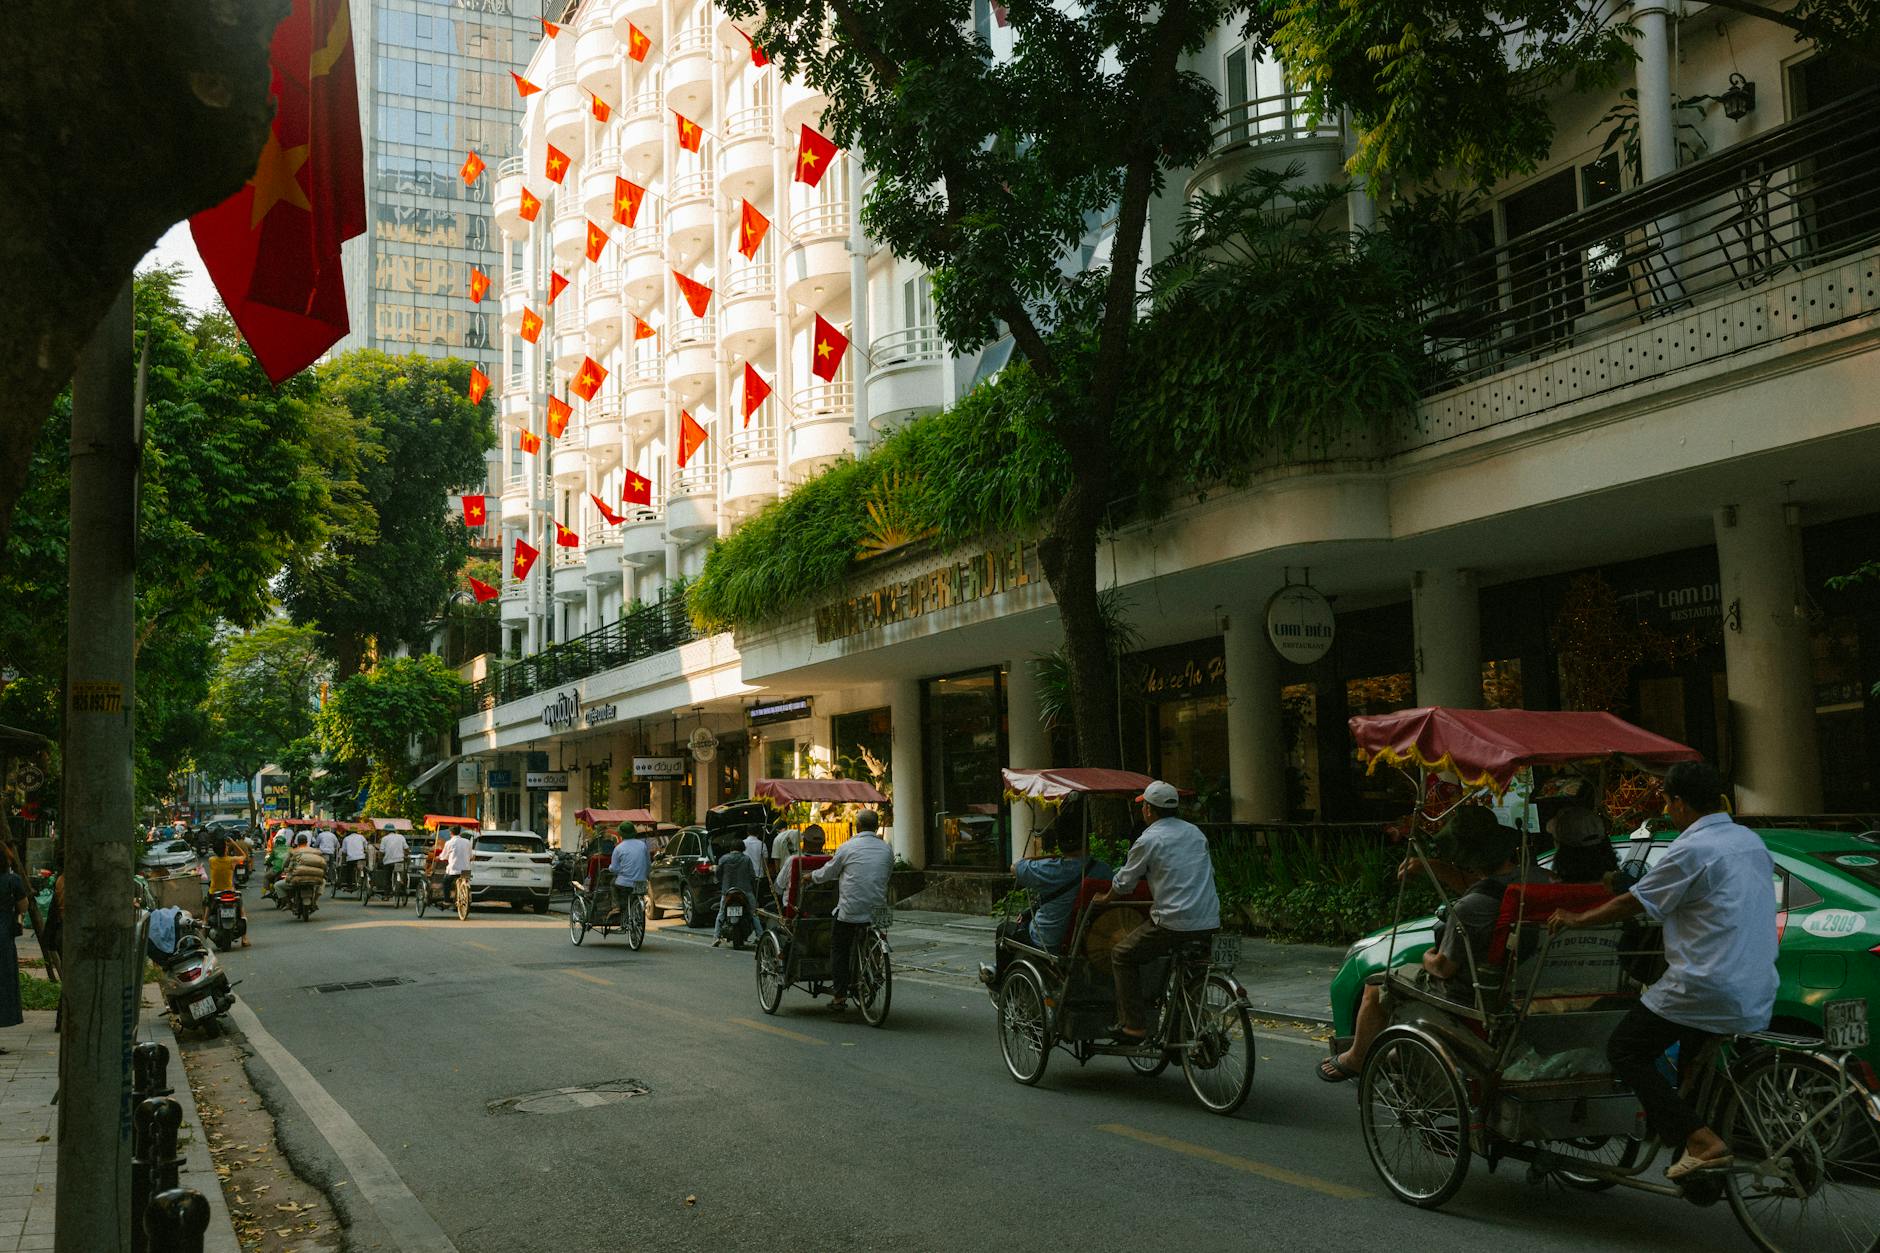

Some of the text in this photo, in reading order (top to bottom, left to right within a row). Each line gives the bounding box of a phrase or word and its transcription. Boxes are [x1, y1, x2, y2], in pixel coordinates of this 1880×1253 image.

[908, 561, 964, 619] OPERA
[968, 540, 1031, 600] HOTEL
[1658, 587, 1699, 608] LAM
[1274, 623, 1301, 637] LAM
[1282, 641, 1324, 650] RESTAURANT
[1822, 913, 1856, 932] 2909
